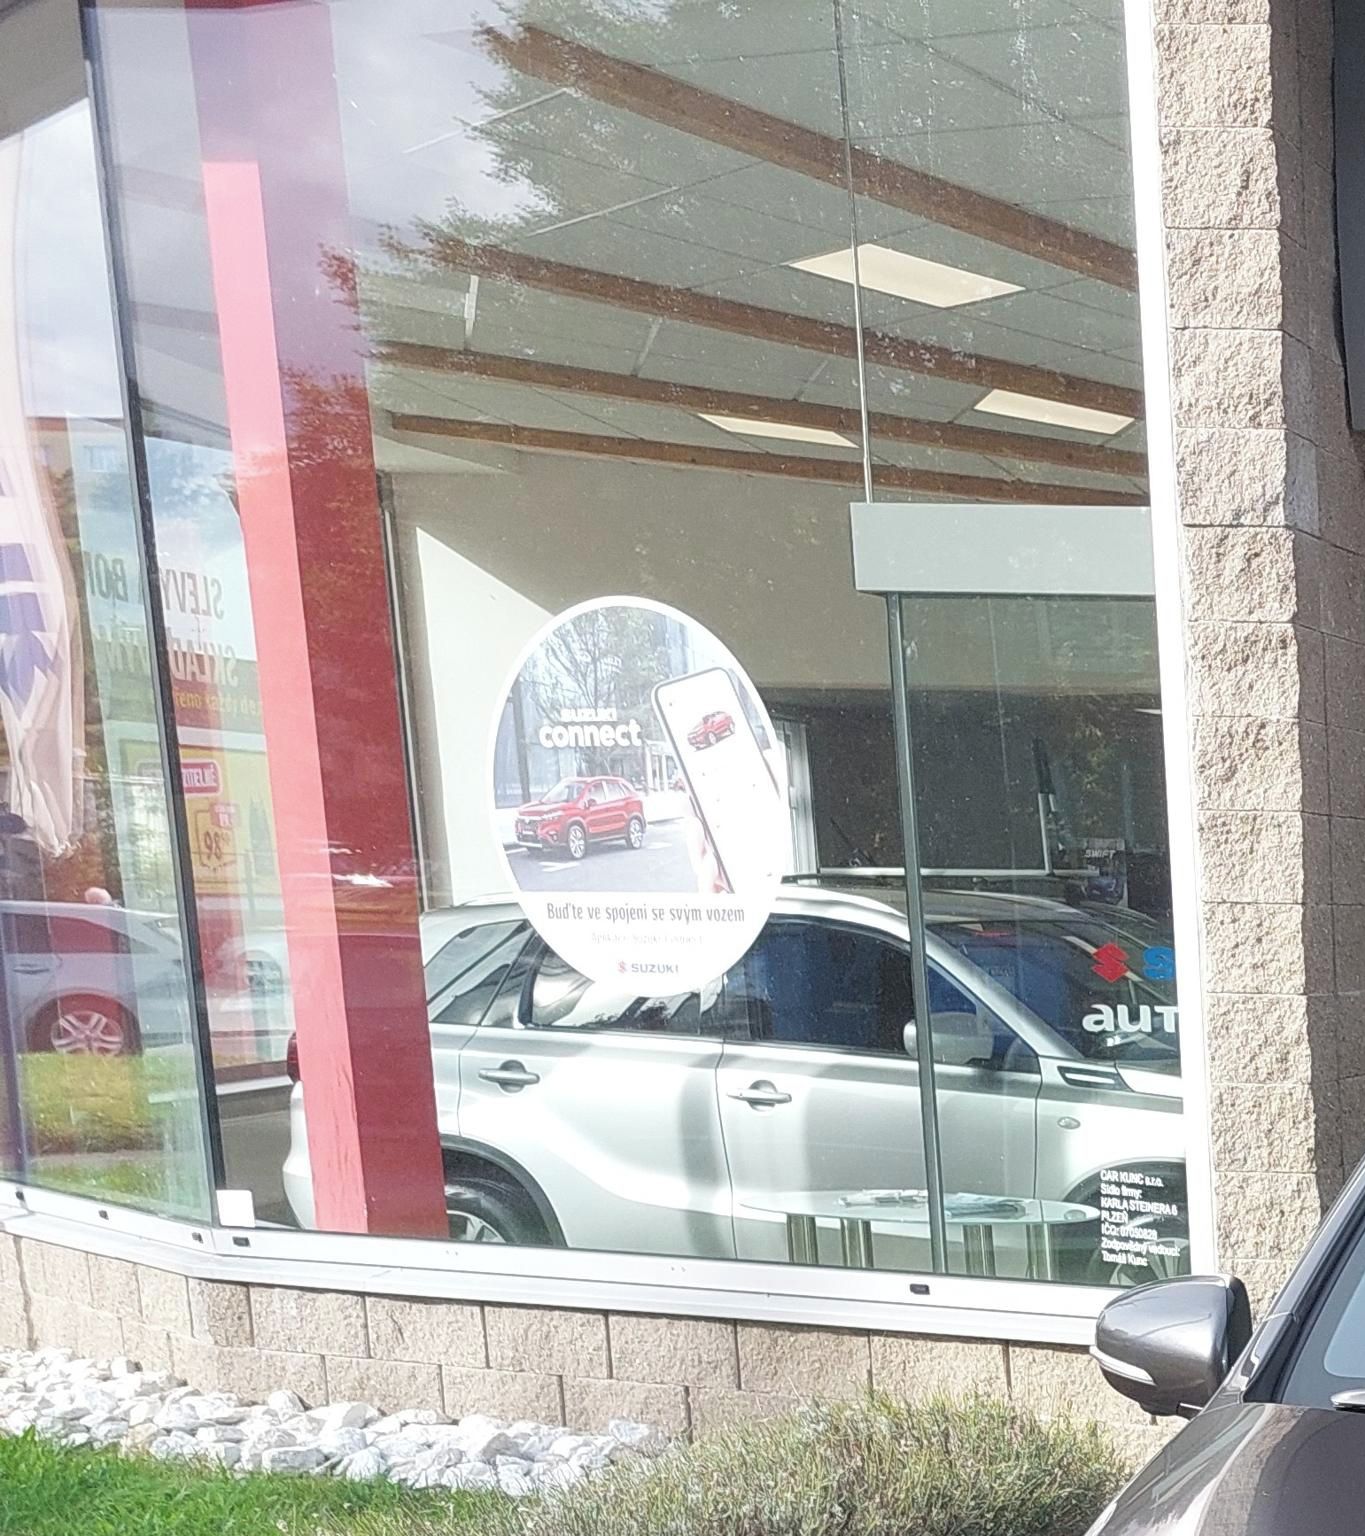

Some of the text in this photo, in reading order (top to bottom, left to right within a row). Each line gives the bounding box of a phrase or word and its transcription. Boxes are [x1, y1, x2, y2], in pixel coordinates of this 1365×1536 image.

[540, 718, 642, 748] connect
[587, 907, 601, 920] ve
[651, 908, 665, 921] se
[706, 907, 745, 923] vozem
[631, 963, 680, 974] SUZUKI
